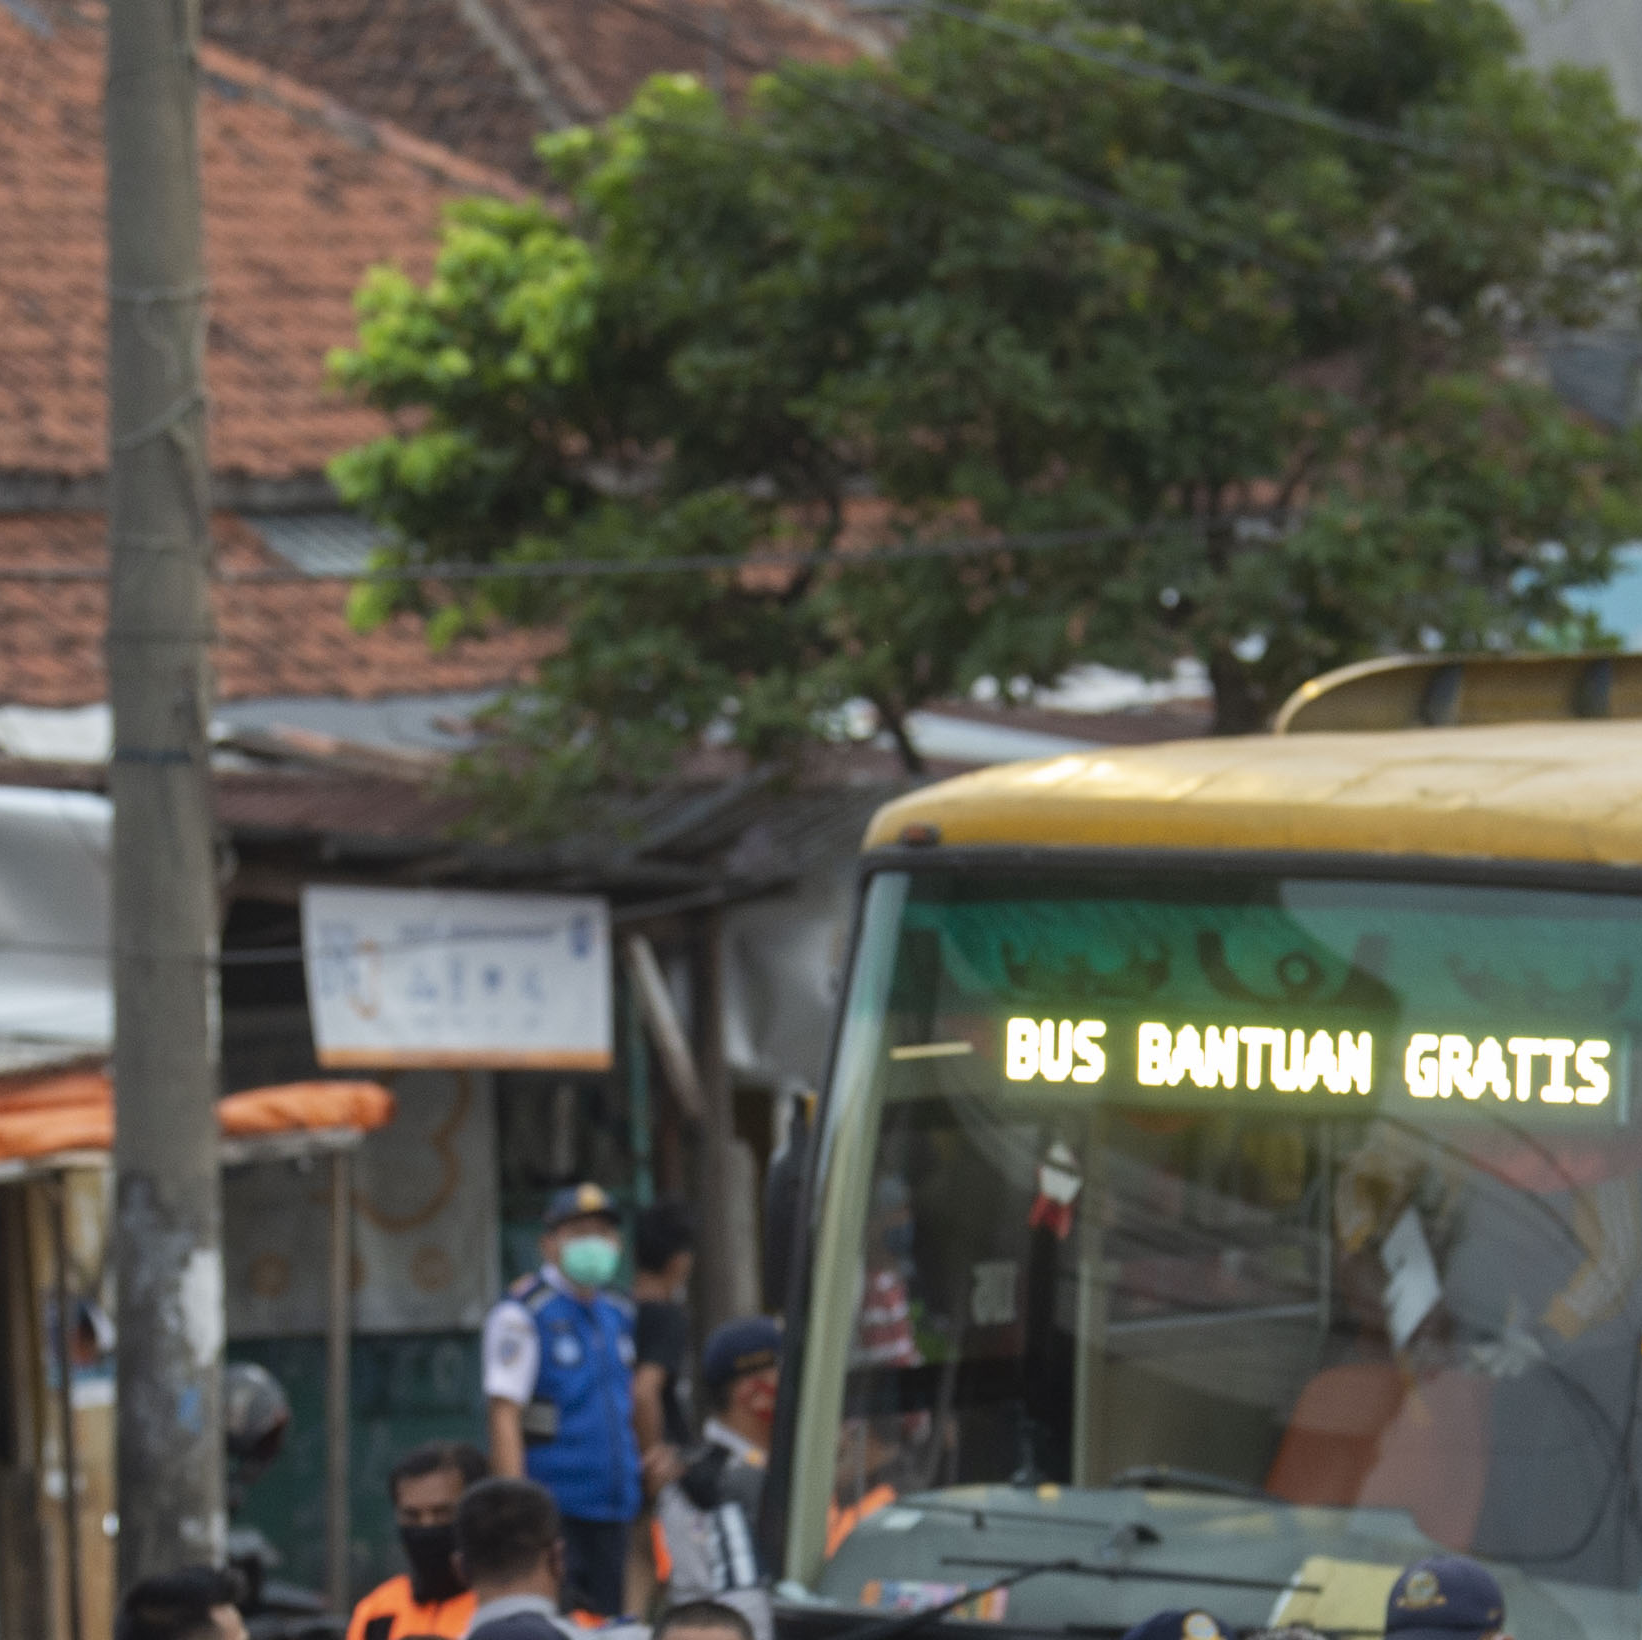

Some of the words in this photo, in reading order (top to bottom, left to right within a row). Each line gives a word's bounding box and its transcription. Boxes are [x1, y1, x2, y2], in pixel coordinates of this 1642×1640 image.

[1007, 1017, 1107, 1083] BUS
[1136, 1021, 1373, 1095] BANTUAN
[1404, 1033, 1611, 1105] GRATIS
